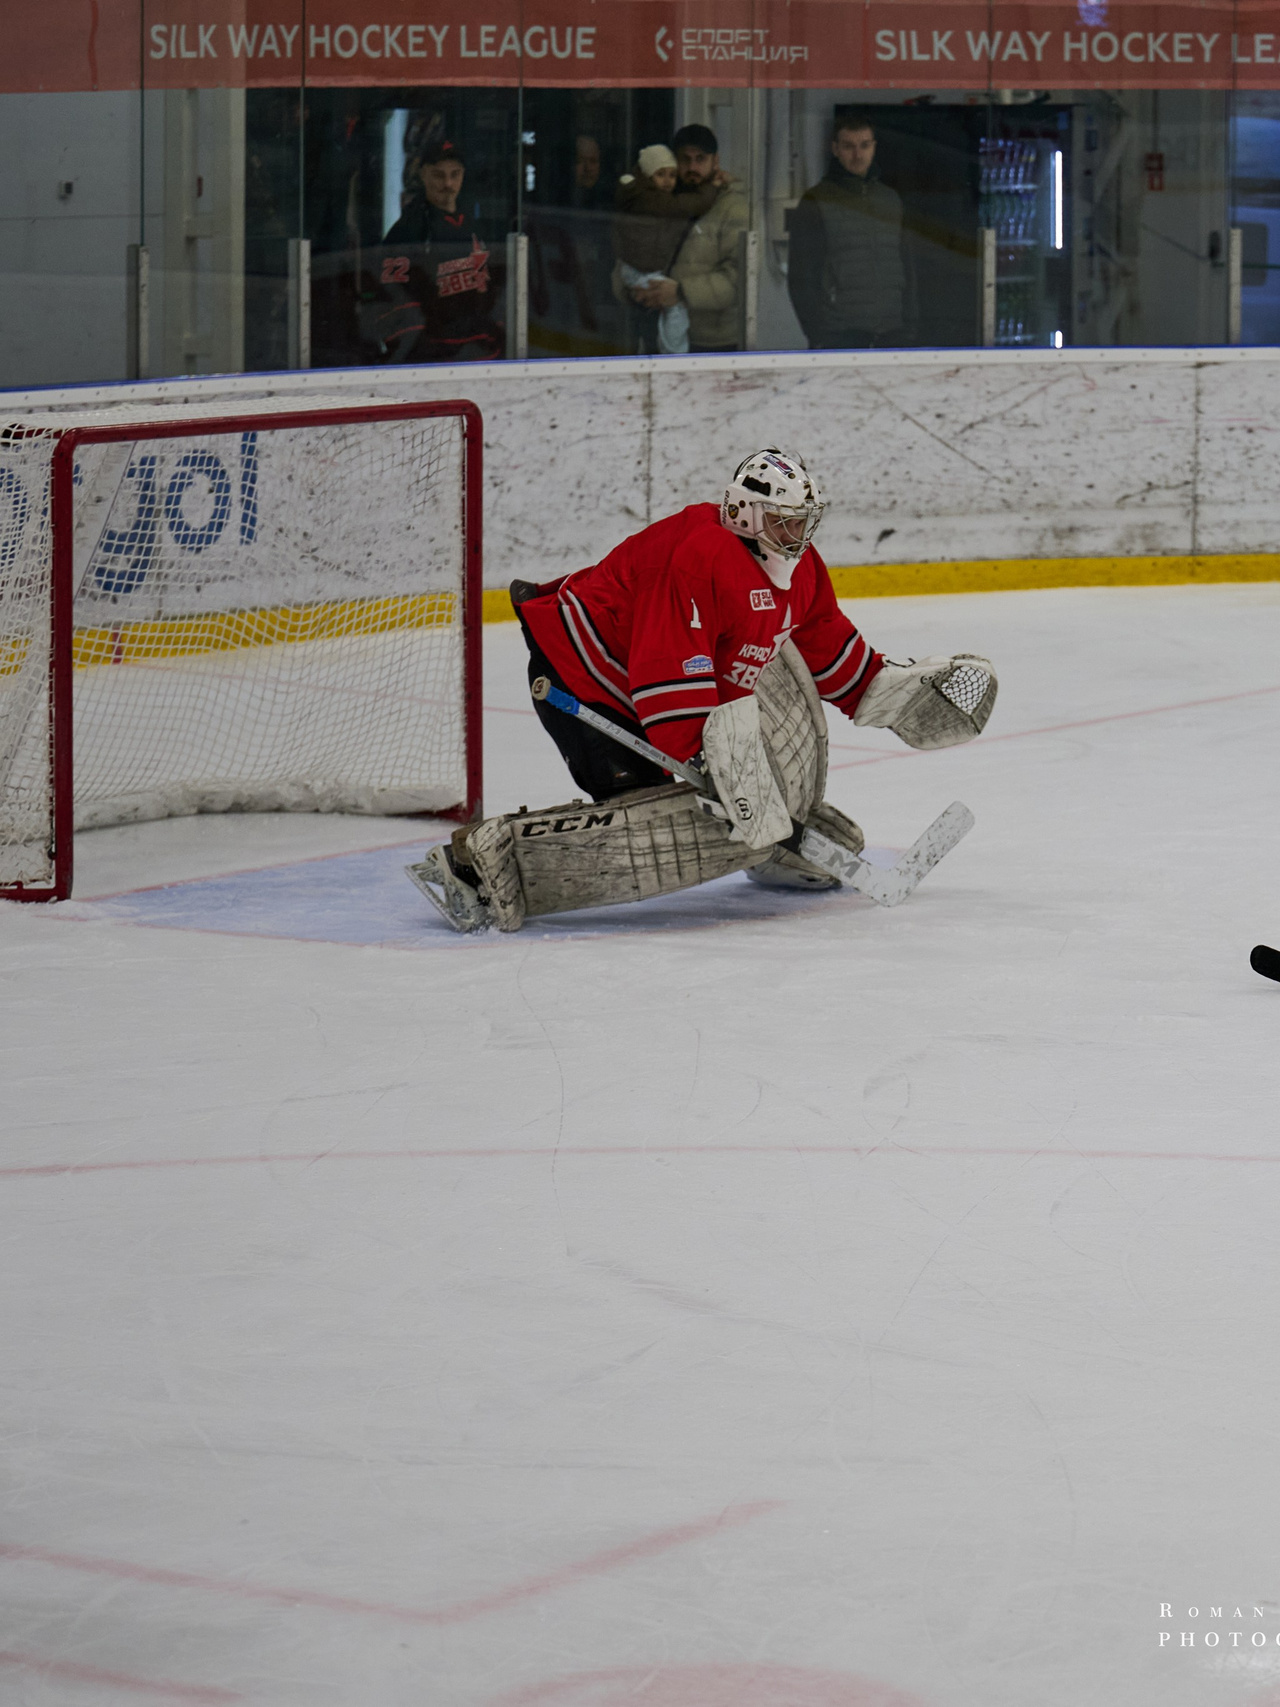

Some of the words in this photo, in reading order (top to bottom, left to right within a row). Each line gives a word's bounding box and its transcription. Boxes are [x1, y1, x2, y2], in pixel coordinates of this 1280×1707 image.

[149, 24, 217, 59] SILK
[227, 24, 300, 58] WAY
[308, 24, 449, 58] HOCKEY
[459, 25, 596, 59] LEAGUE
[681, 28, 770, 44] СПОРТ
[875, 29, 955, 61] SILK
[965, 30, 1051, 61] WAY
[1063, 31, 1220, 63] HOCKEY
[681, 45, 809, 64] СТАНЦИЯ
[521, 811, 615, 838] CCM
